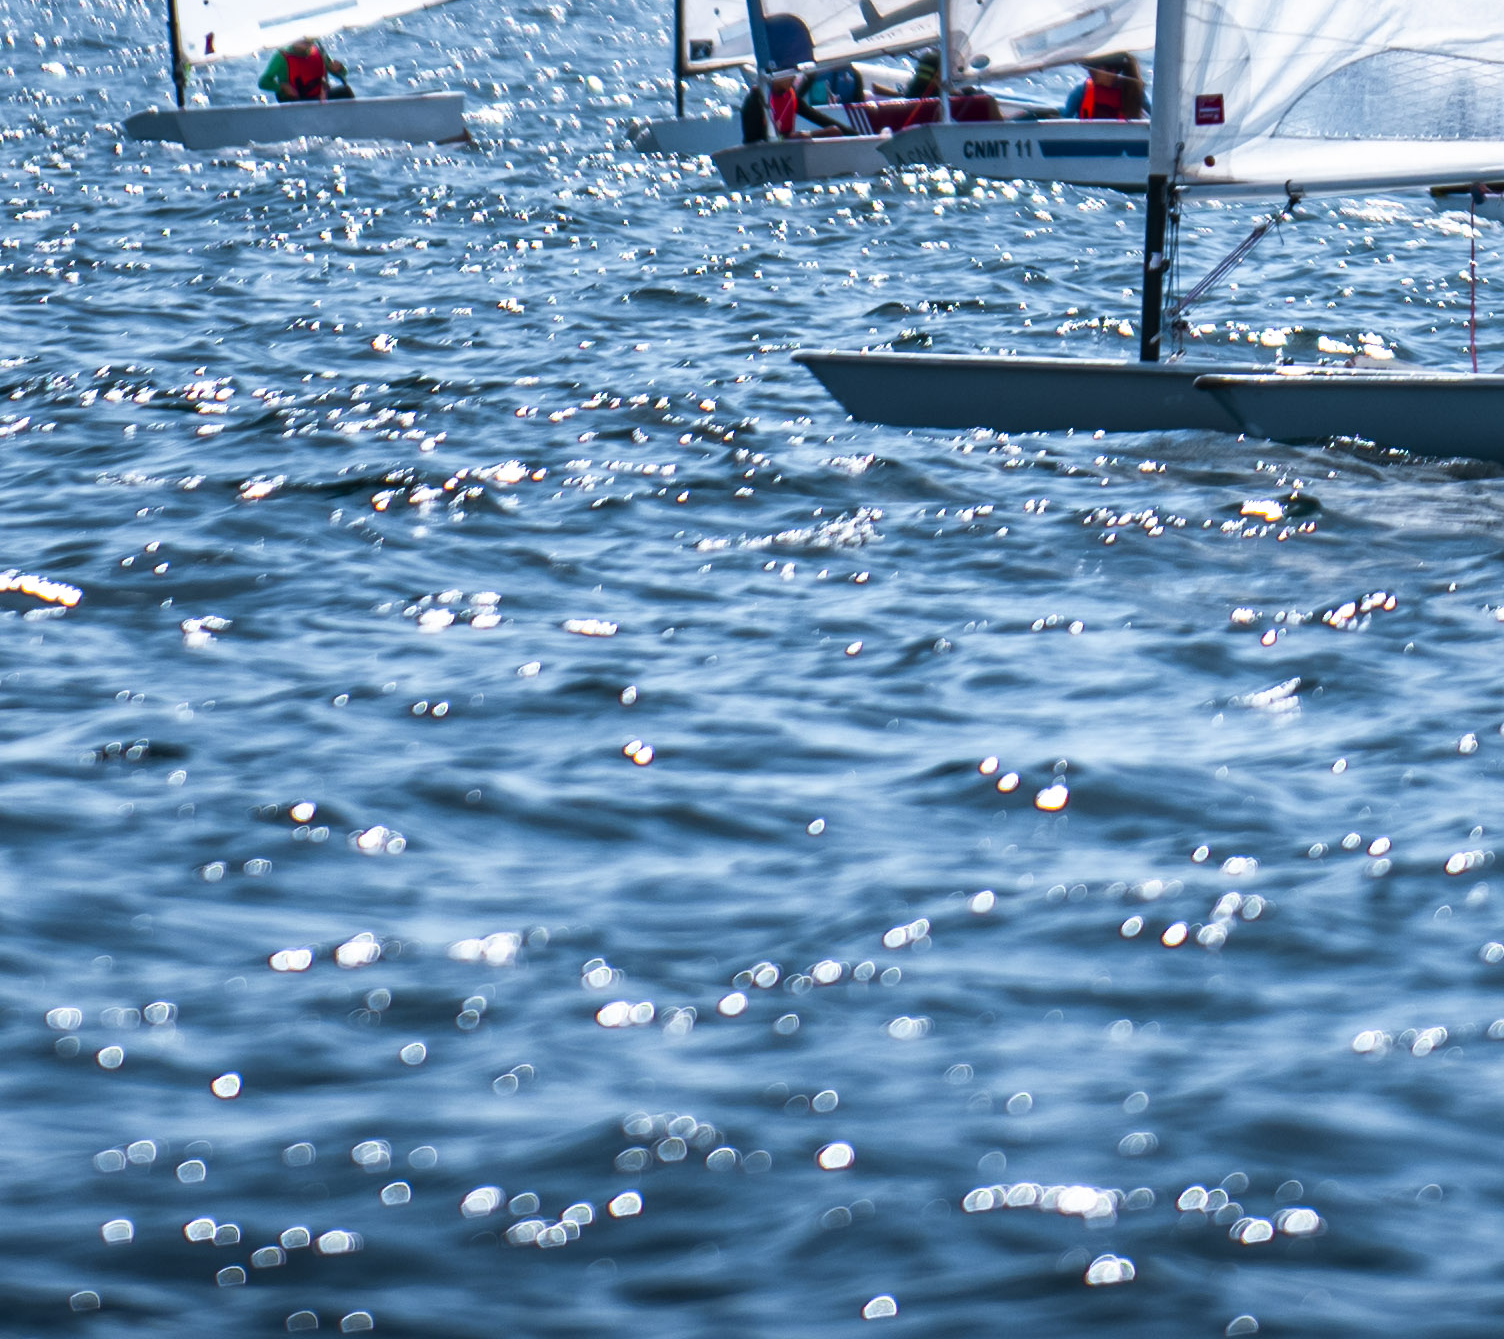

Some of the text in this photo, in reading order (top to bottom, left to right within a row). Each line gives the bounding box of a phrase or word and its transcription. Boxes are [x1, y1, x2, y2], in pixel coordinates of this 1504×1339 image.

[963, 138, 1033, 159] CNMT 11
[734, 153, 795, 185] ASMK
